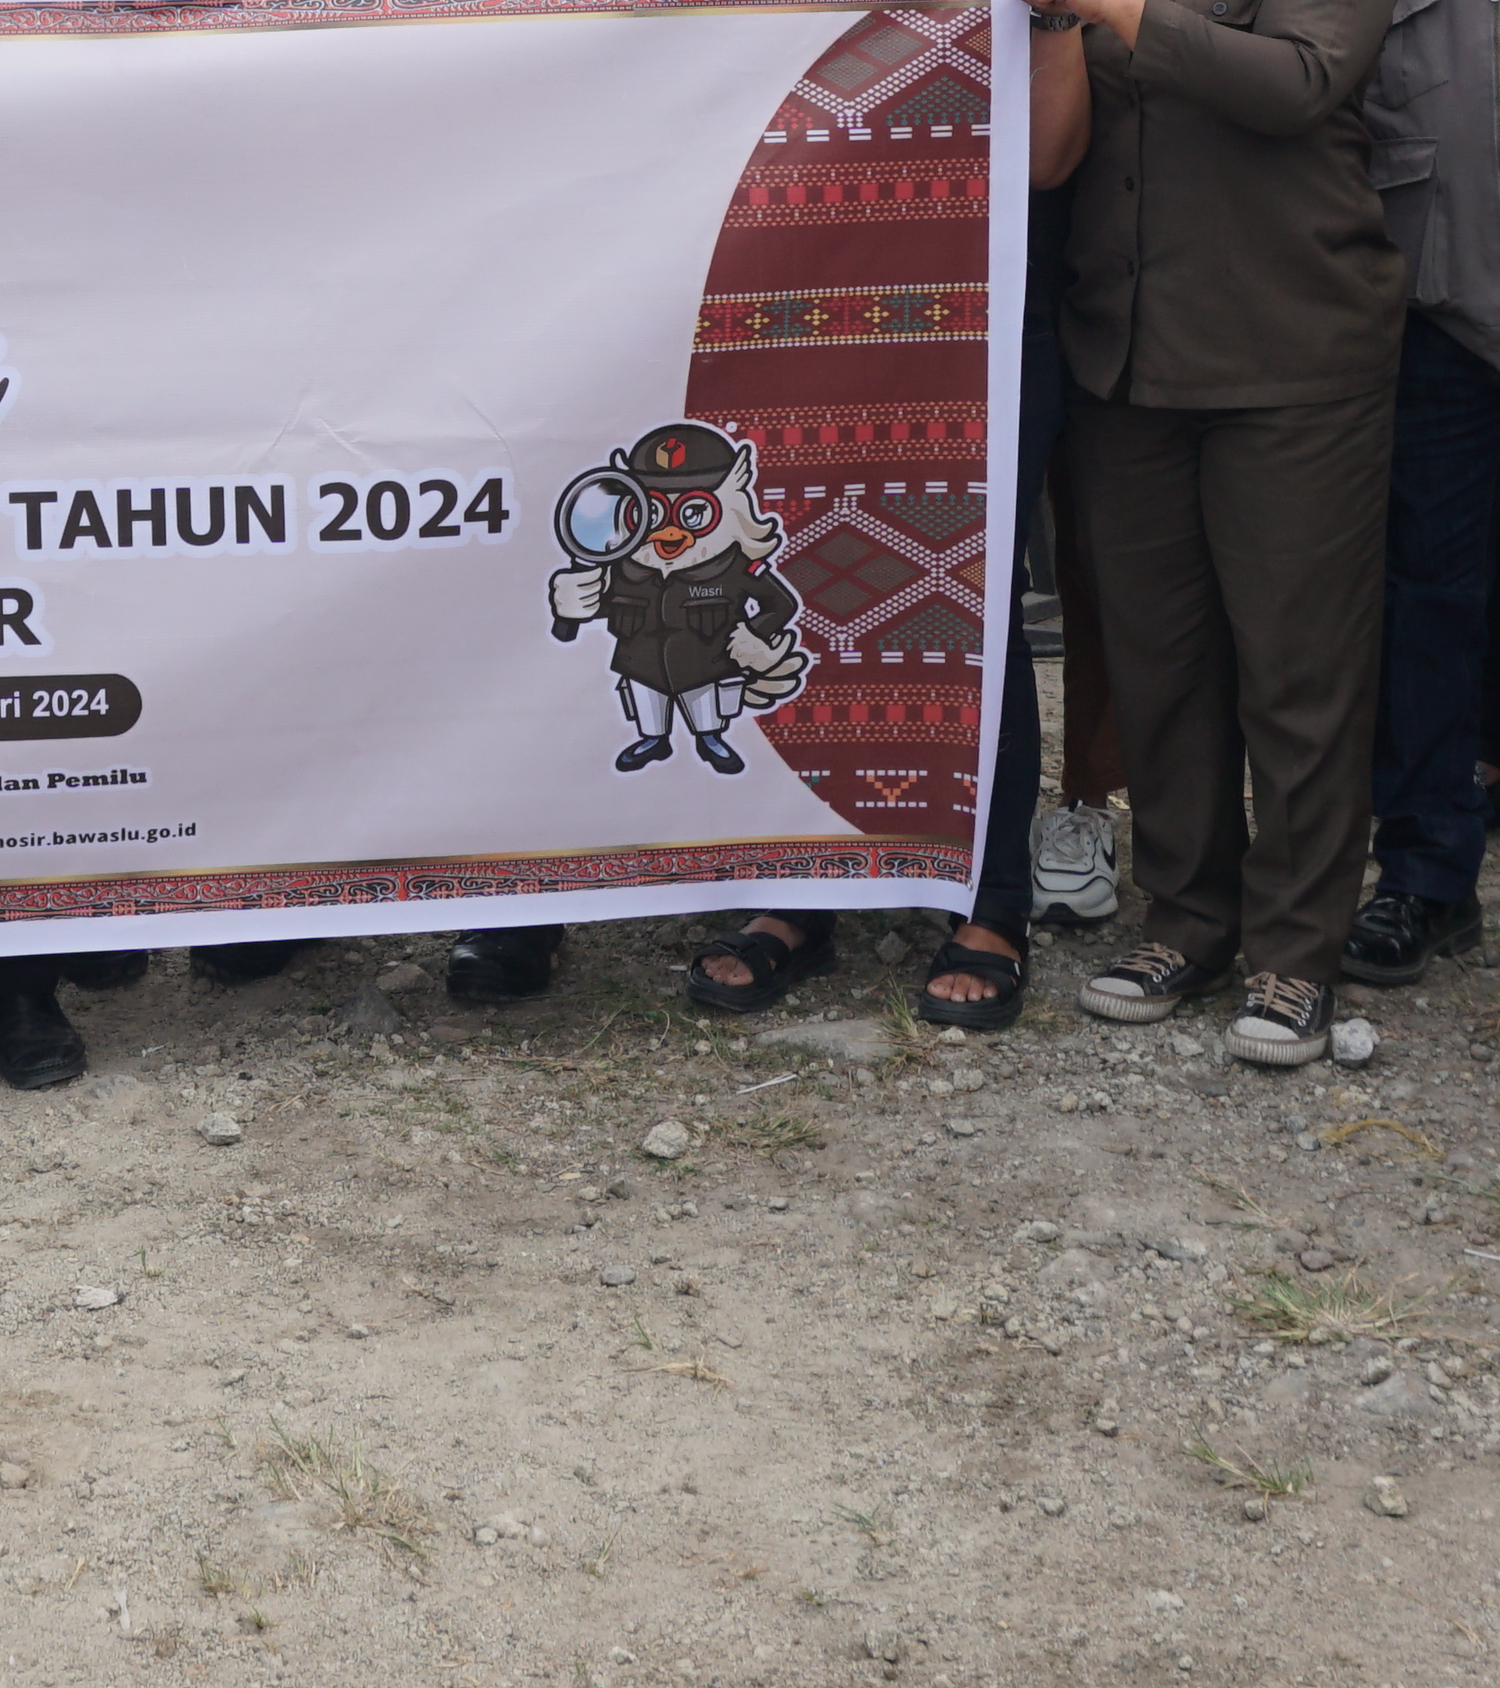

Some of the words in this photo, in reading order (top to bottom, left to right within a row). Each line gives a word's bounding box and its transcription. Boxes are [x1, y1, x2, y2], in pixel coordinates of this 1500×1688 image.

[9, 484, 287, 550] TAHUN
[318, 476, 511, 542] 2024
[688, 585, 723, 597] Wasri
[32, 687, 109, 717] 2024
[46, 768, 148, 790] Pemilu
